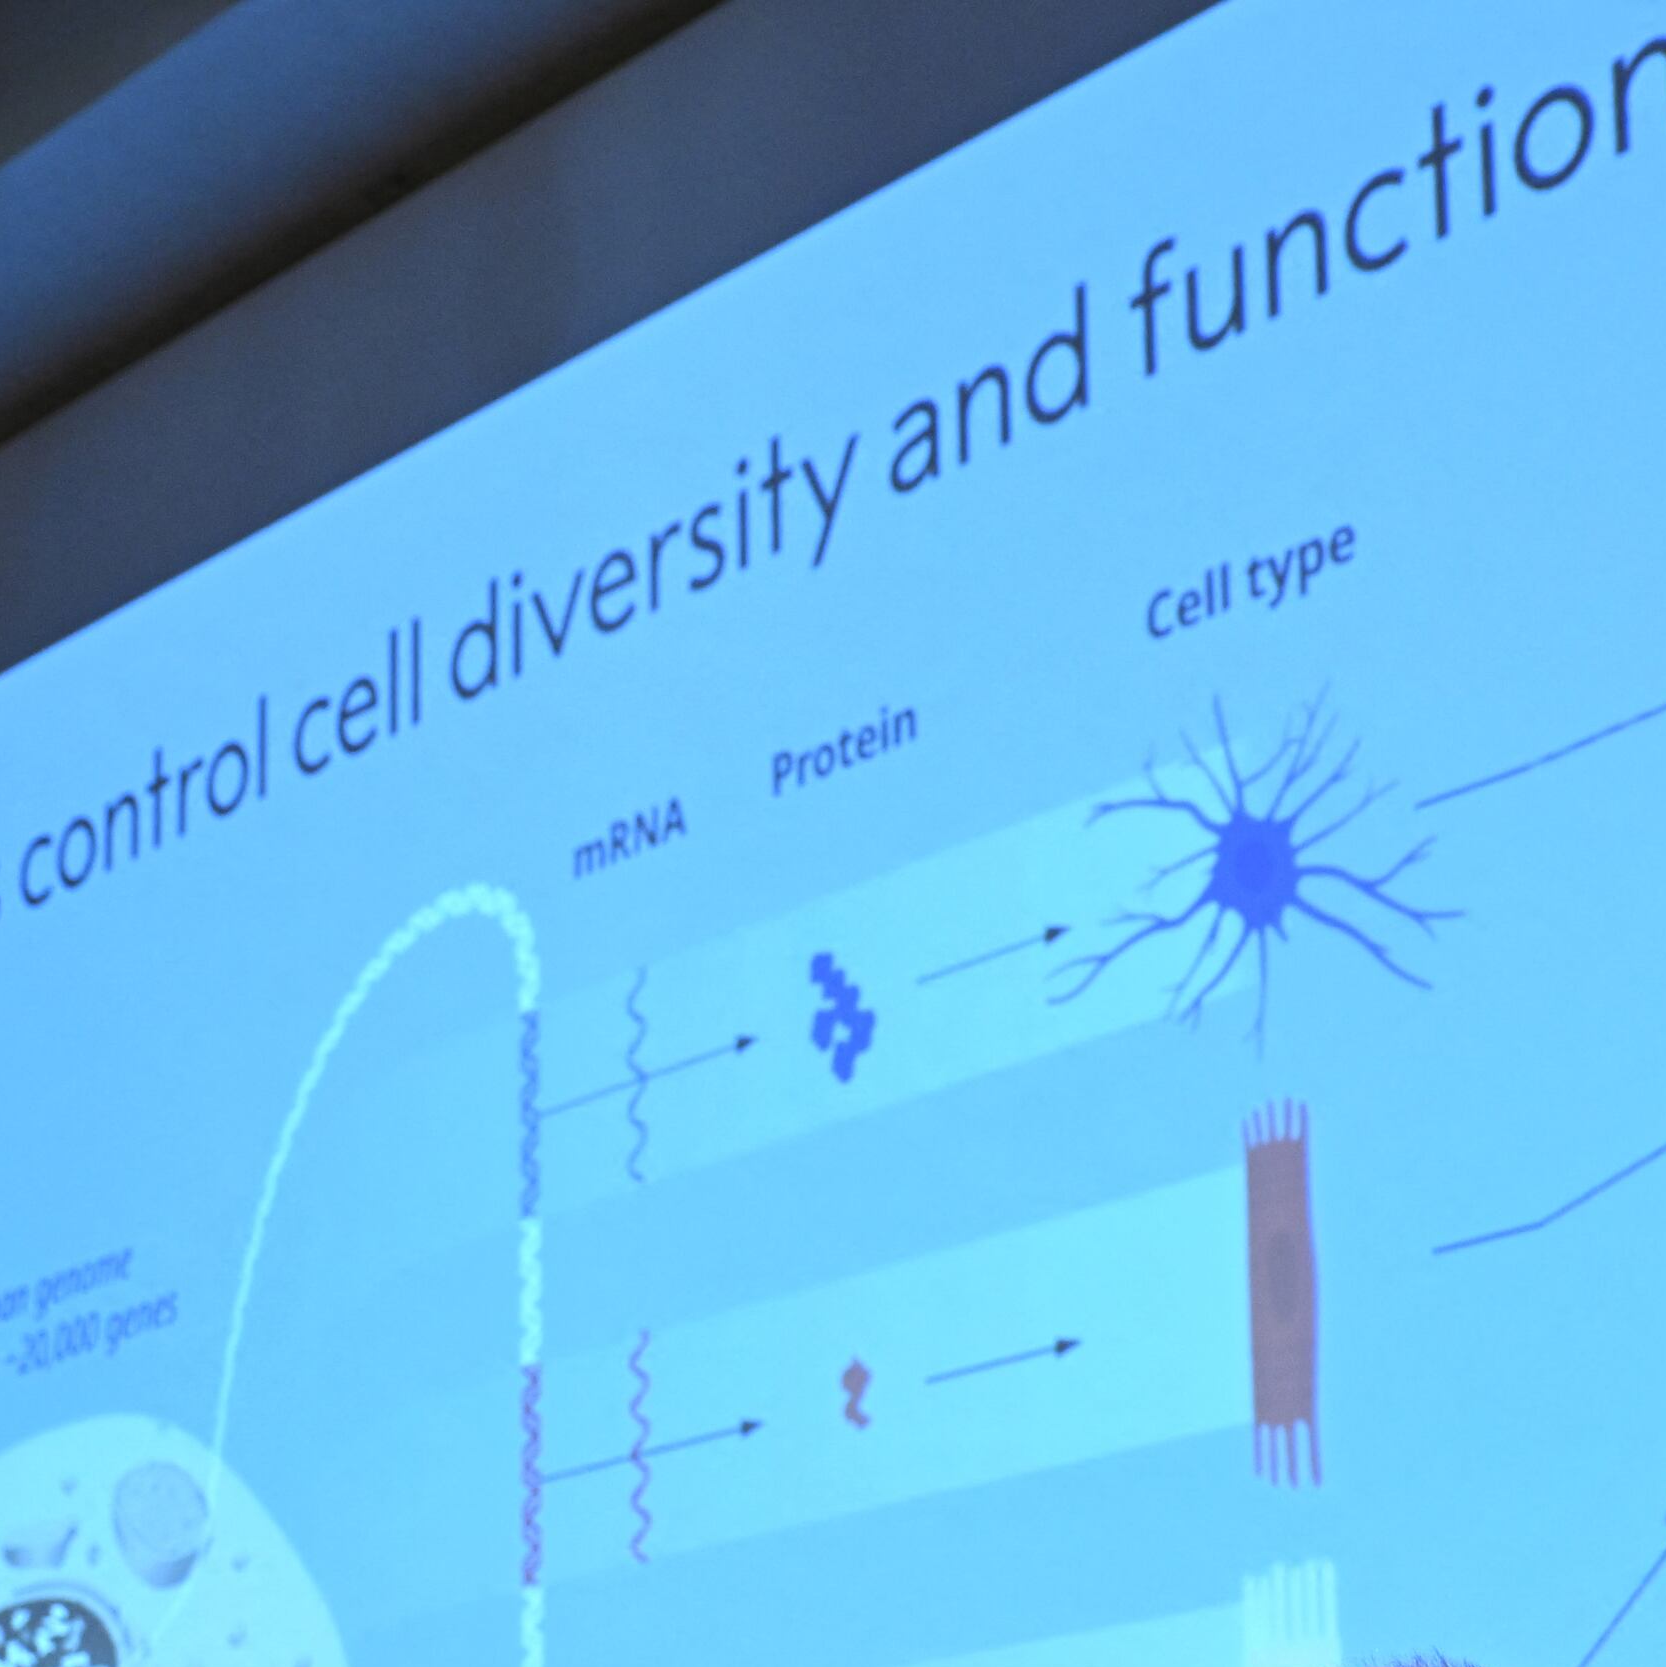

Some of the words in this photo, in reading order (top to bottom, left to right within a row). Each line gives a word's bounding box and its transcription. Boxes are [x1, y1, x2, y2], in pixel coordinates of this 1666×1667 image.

[15, 691, 272, 911] control
[287, 614, 424, 780] cell
[445, 430, 863, 706] diversity
[884, 279, 1094, 497] and
[1144, 561, 1233, 641] Cell
[1243, 522, 1358, 612] type
[769, 704, 919, 799] Protein
[571, 795, 690, 880] mRNA
